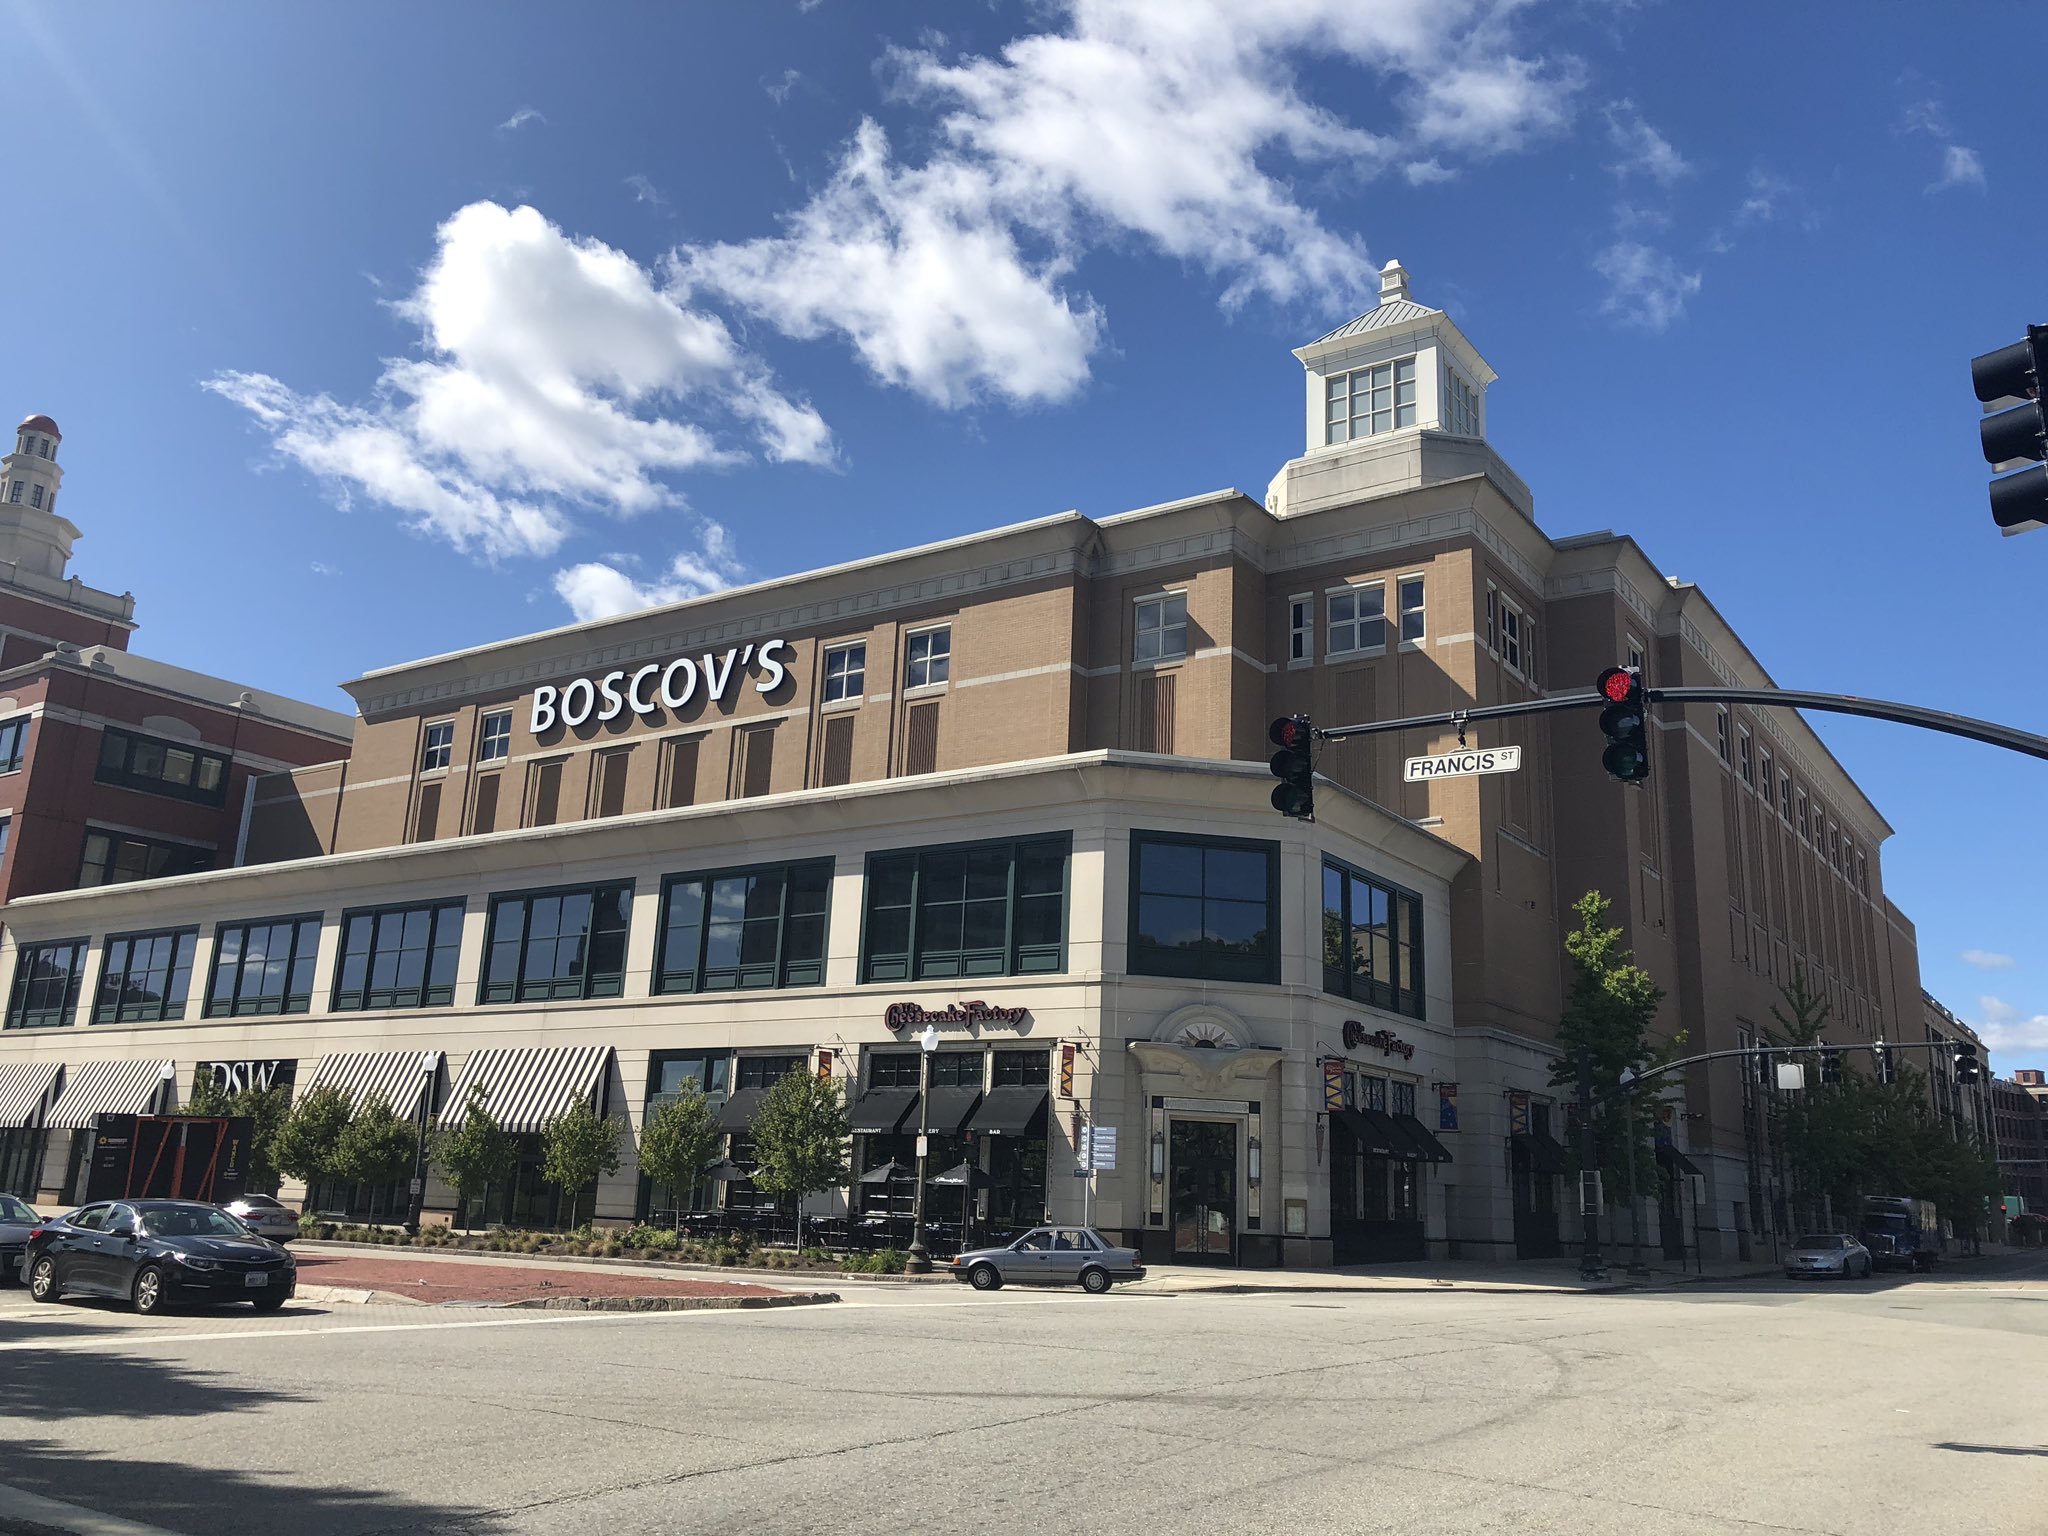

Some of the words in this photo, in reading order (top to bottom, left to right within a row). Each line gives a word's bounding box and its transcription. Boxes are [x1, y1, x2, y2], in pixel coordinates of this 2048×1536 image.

[530, 639, 785, 734] BOSCOV'S
[1410, 753, 1495, 777] FRANCIS
[1501, 751, 1514, 760] ST
[885, 1003, 964, 1031] Cheesecake
[960, 1000, 1027, 1028] Factory
[209, 1061, 280, 1098] DSW
